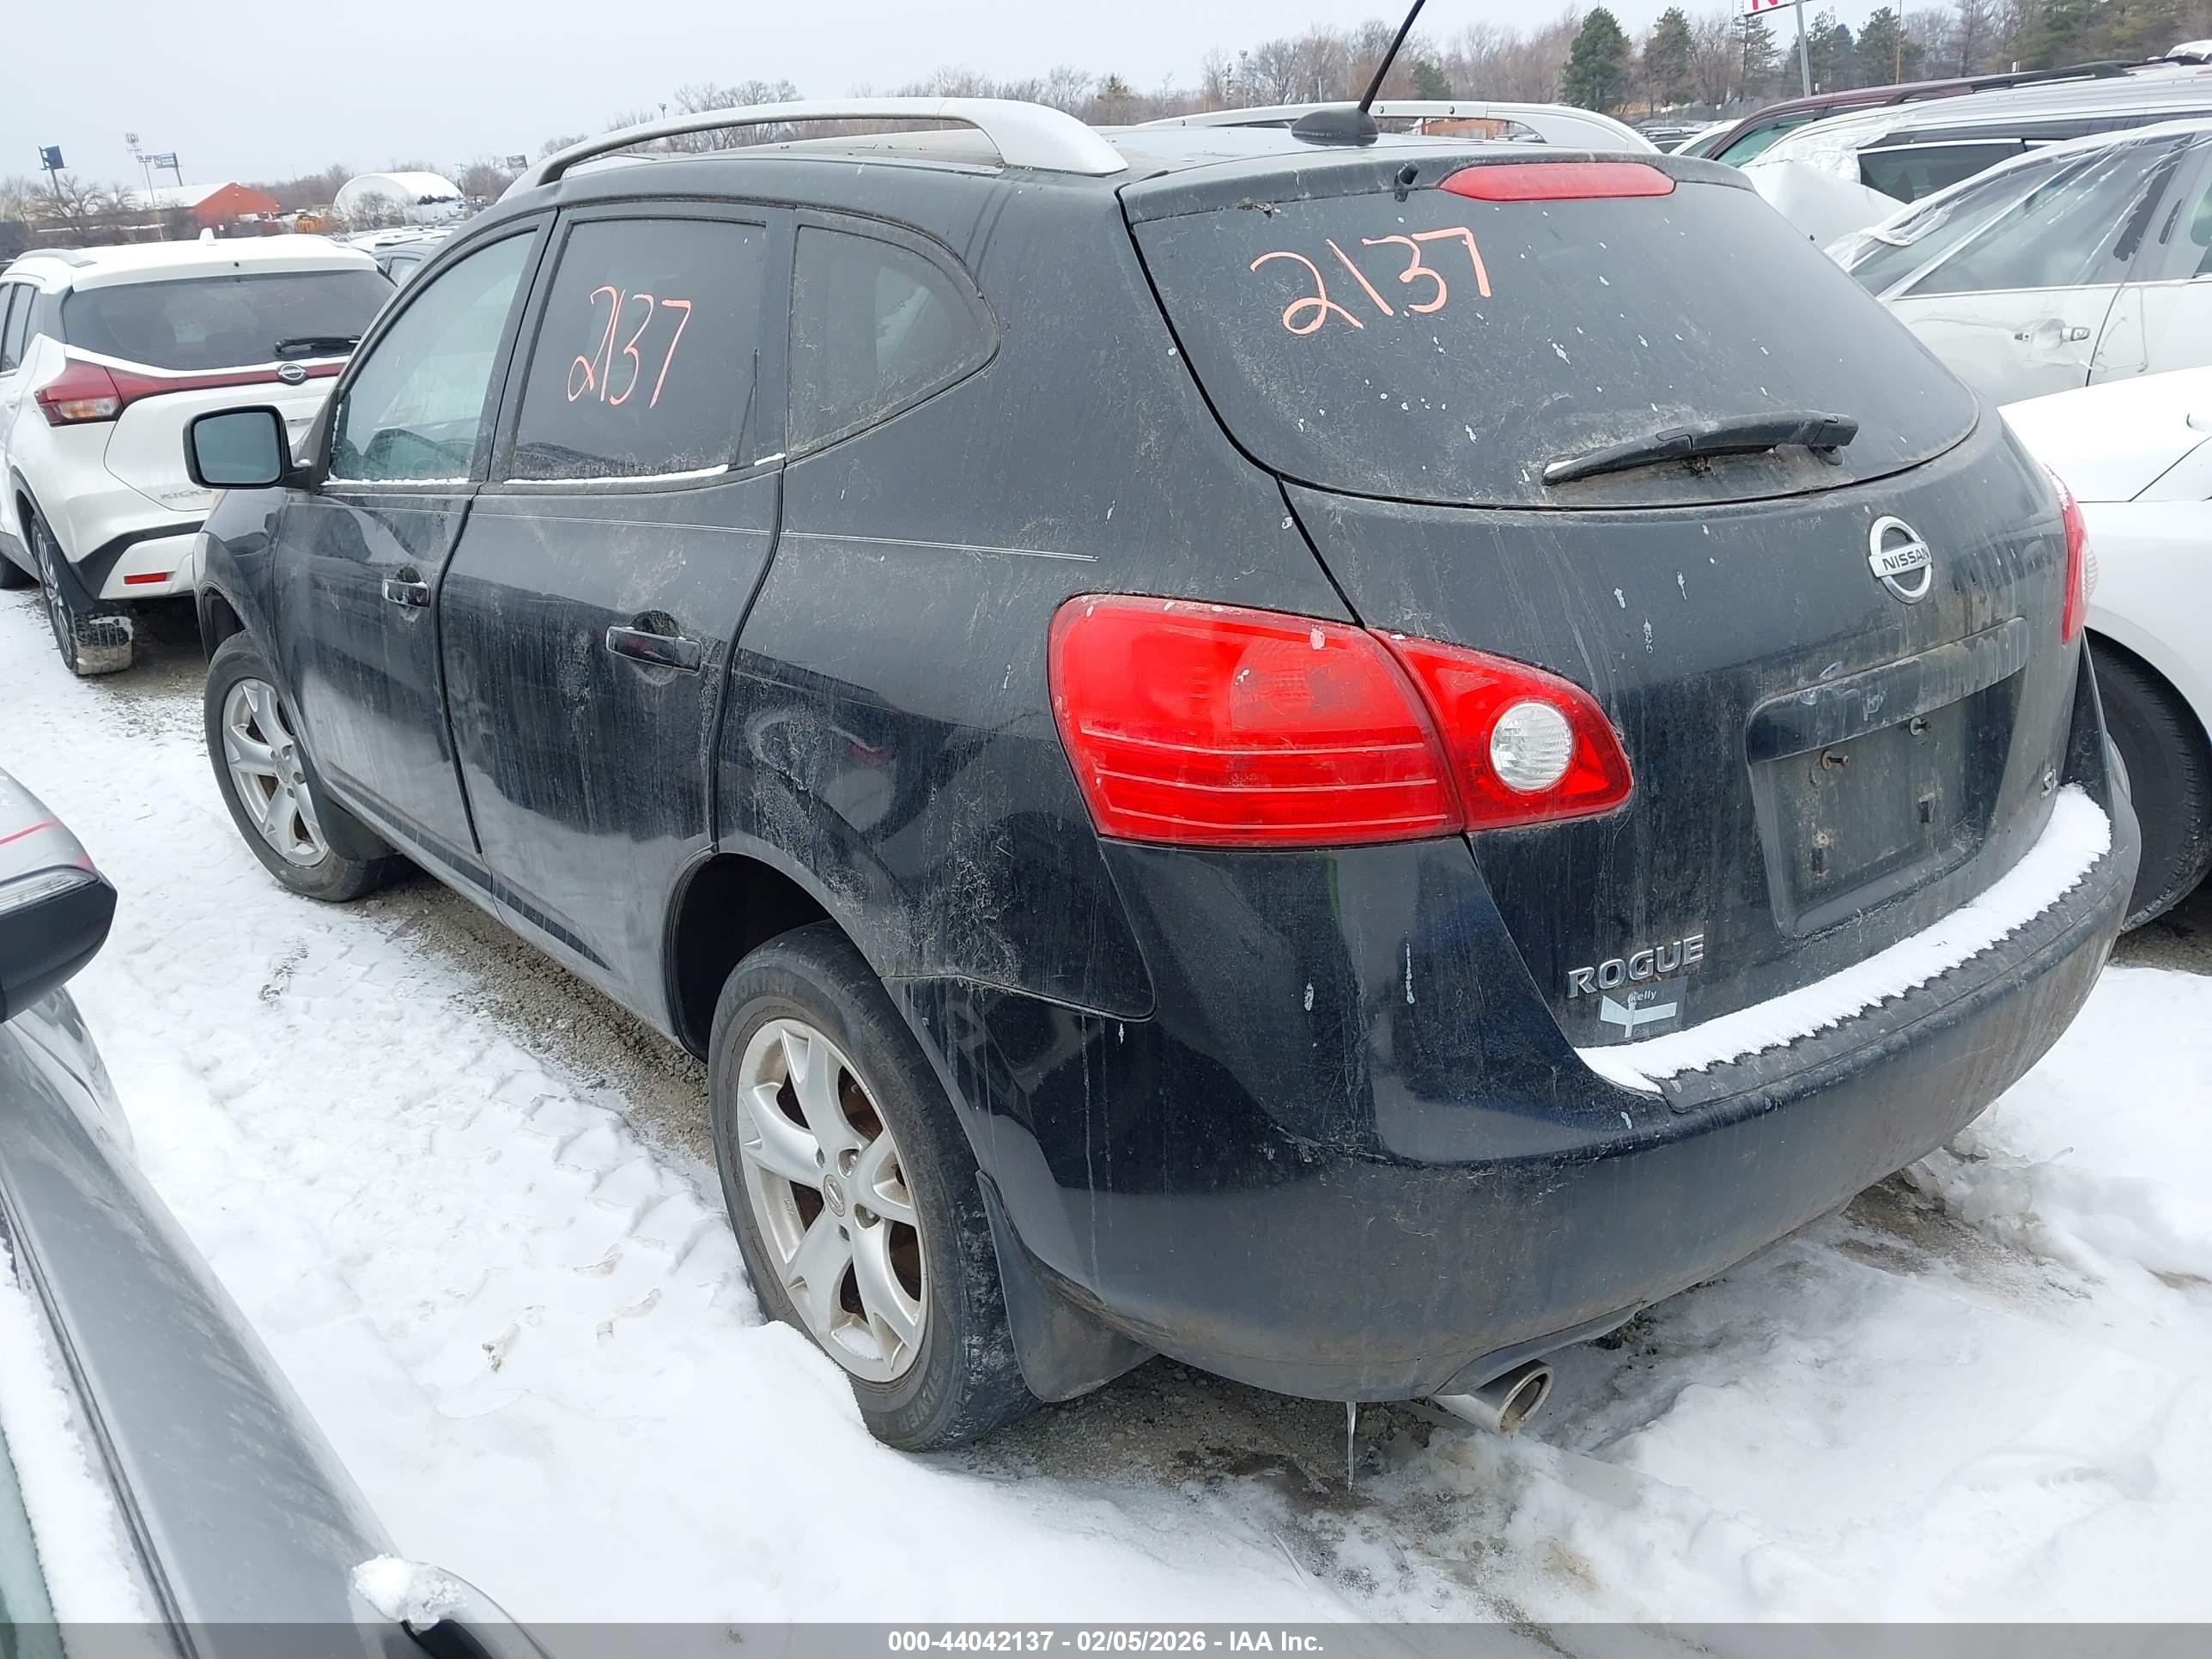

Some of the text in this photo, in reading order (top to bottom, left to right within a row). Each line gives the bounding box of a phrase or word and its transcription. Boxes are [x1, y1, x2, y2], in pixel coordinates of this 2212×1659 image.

[1249, 227, 1492, 335] 2137
[568, 286, 691, 409] 2137
[1881, 547, 1930, 570] NISSAN
[1567, 933, 1705, 999] ROGUE
